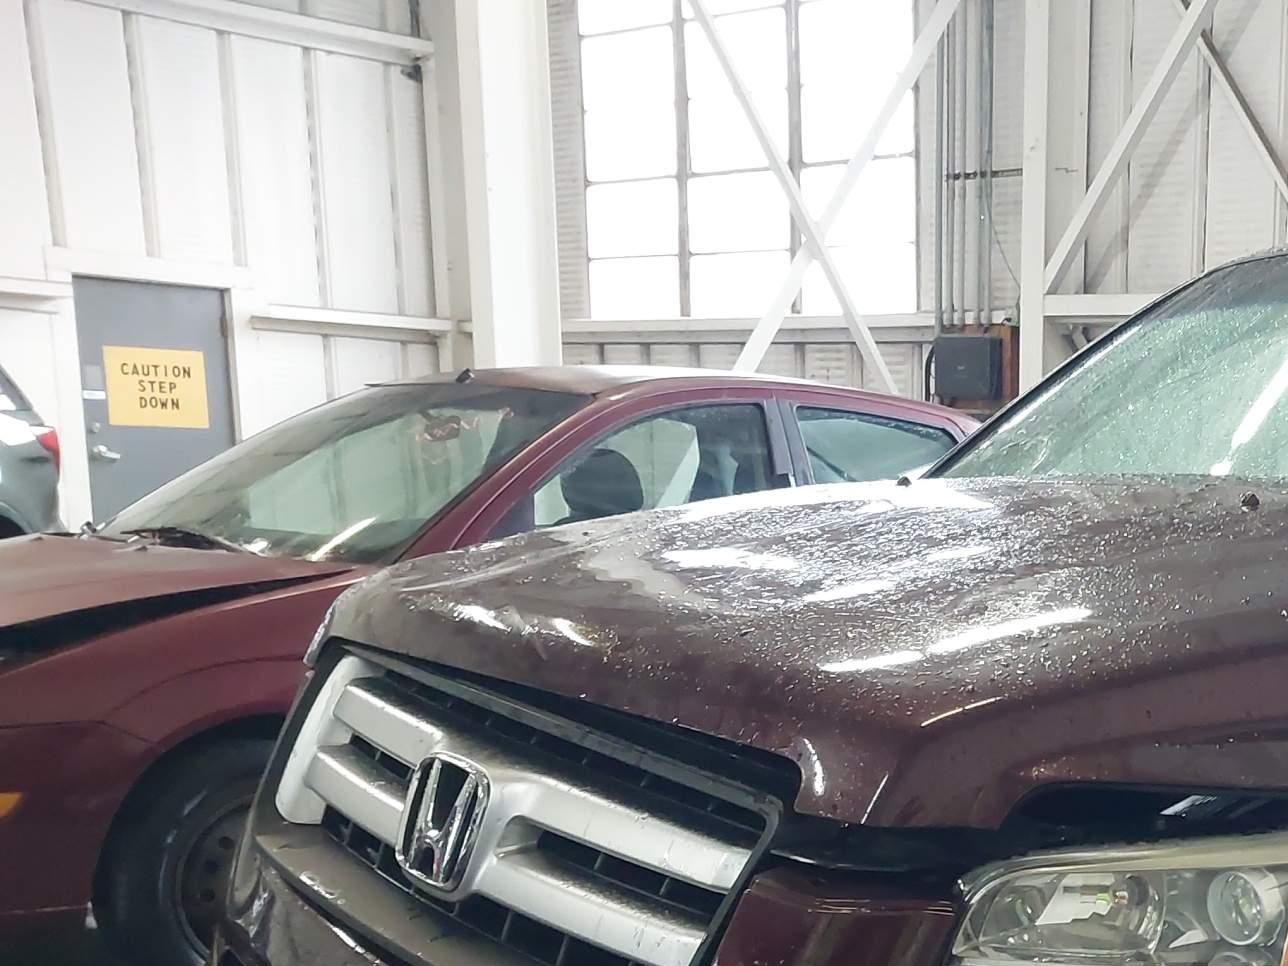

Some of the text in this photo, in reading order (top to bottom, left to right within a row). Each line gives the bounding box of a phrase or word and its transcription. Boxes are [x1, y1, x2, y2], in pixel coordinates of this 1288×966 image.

[120, 362, 191, 378] CAUTION
[138, 380, 177, 393] STEP
[139, 396, 180, 410] DOWN
